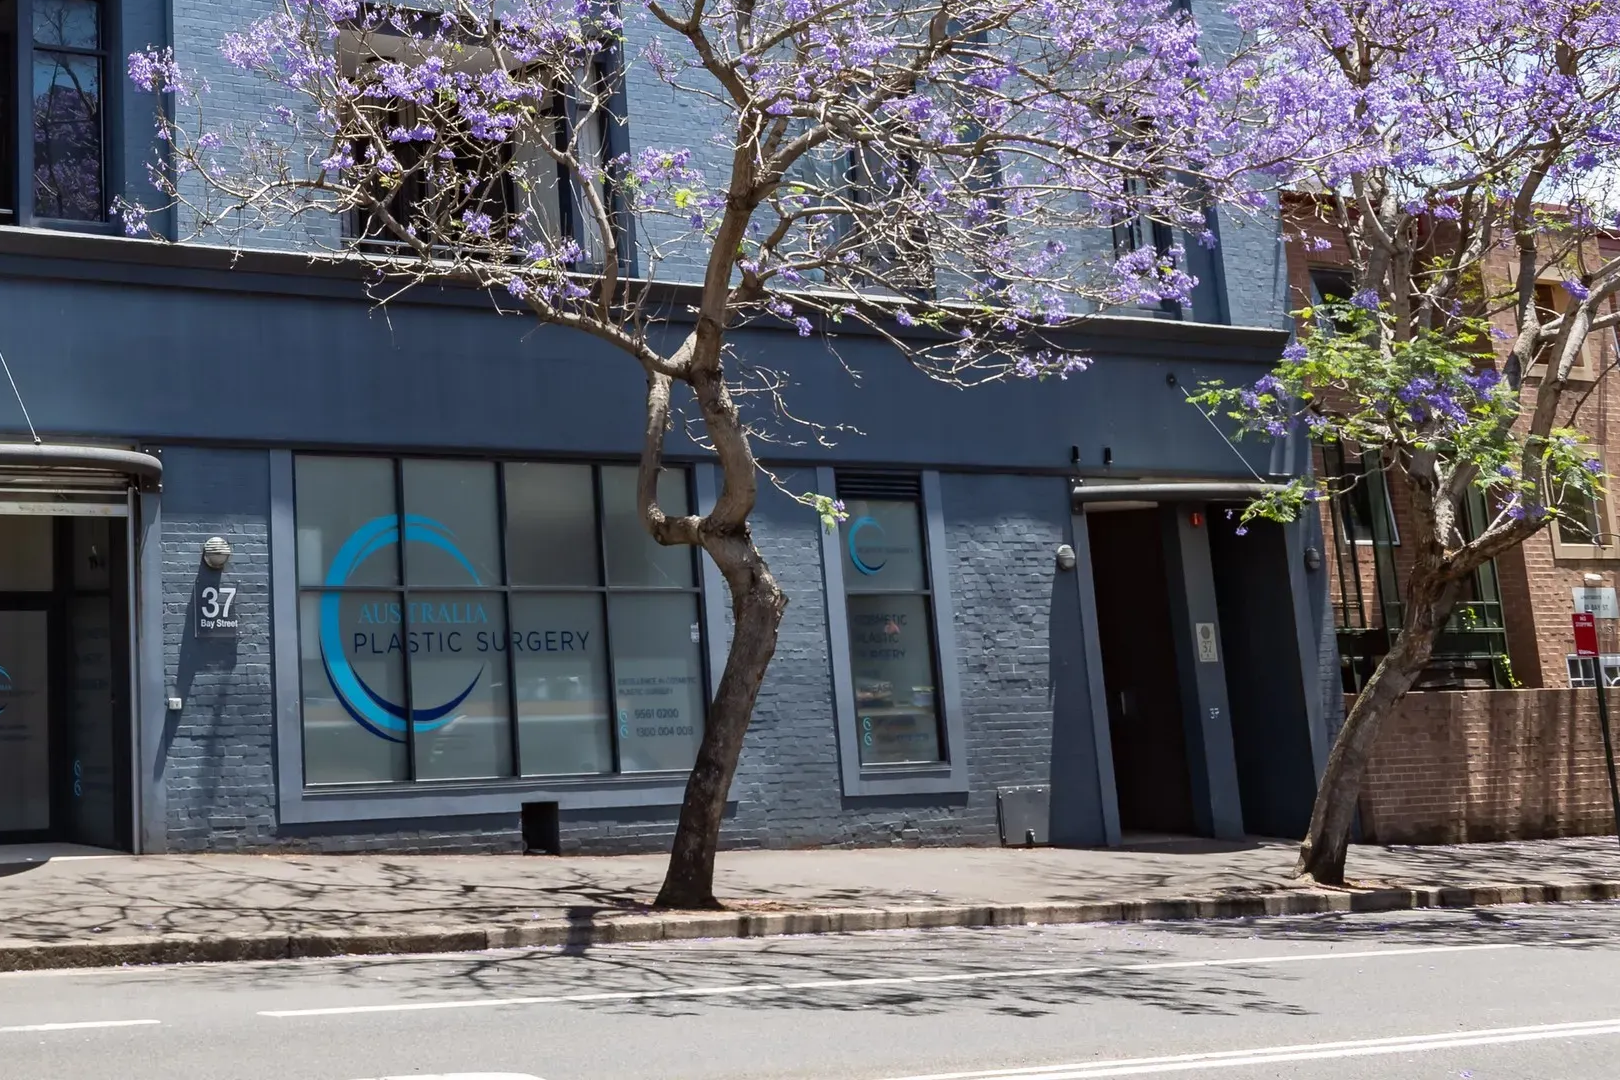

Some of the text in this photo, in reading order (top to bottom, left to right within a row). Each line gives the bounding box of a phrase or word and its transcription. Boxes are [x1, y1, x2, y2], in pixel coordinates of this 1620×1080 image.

[202, 586, 236, 618] 37
[200, 618, 238, 629] Bay Street
[358, 603, 488, 624] AUSTRALIA
[354, 631, 590, 654] PLASTIC SURGERY
[1201, 640, 1212, 653] 37
